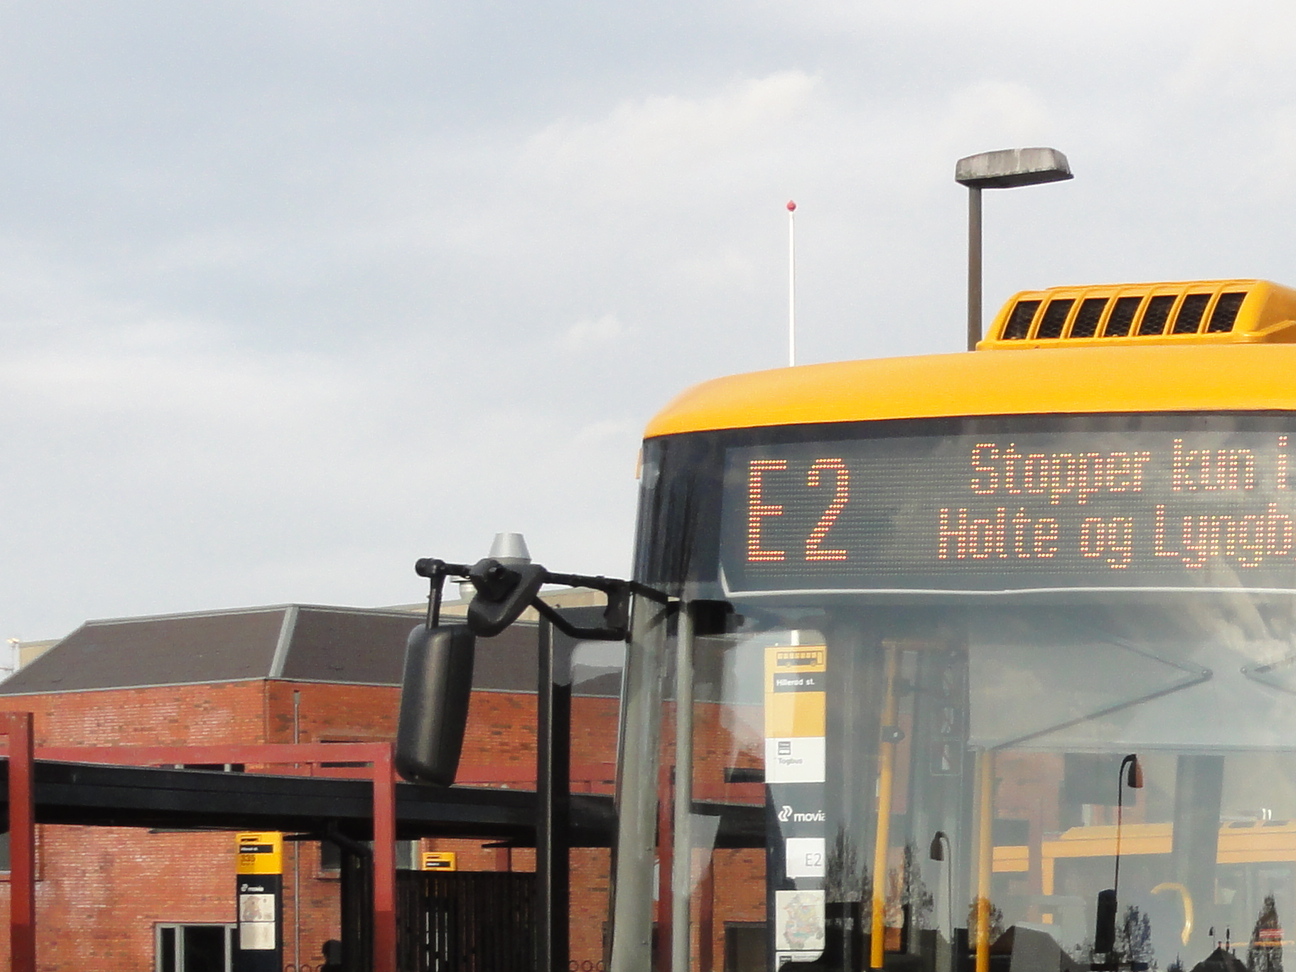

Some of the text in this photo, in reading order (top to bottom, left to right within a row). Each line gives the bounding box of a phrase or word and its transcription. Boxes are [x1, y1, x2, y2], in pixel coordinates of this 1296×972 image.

[971, 435, 1288, 504] Stopper kun i
[746, 457, 850, 562] E2
[938, 507, 1059, 560] Holte
[1079, 516, 1133, 569] og
[805, 853, 822, 867] E2
